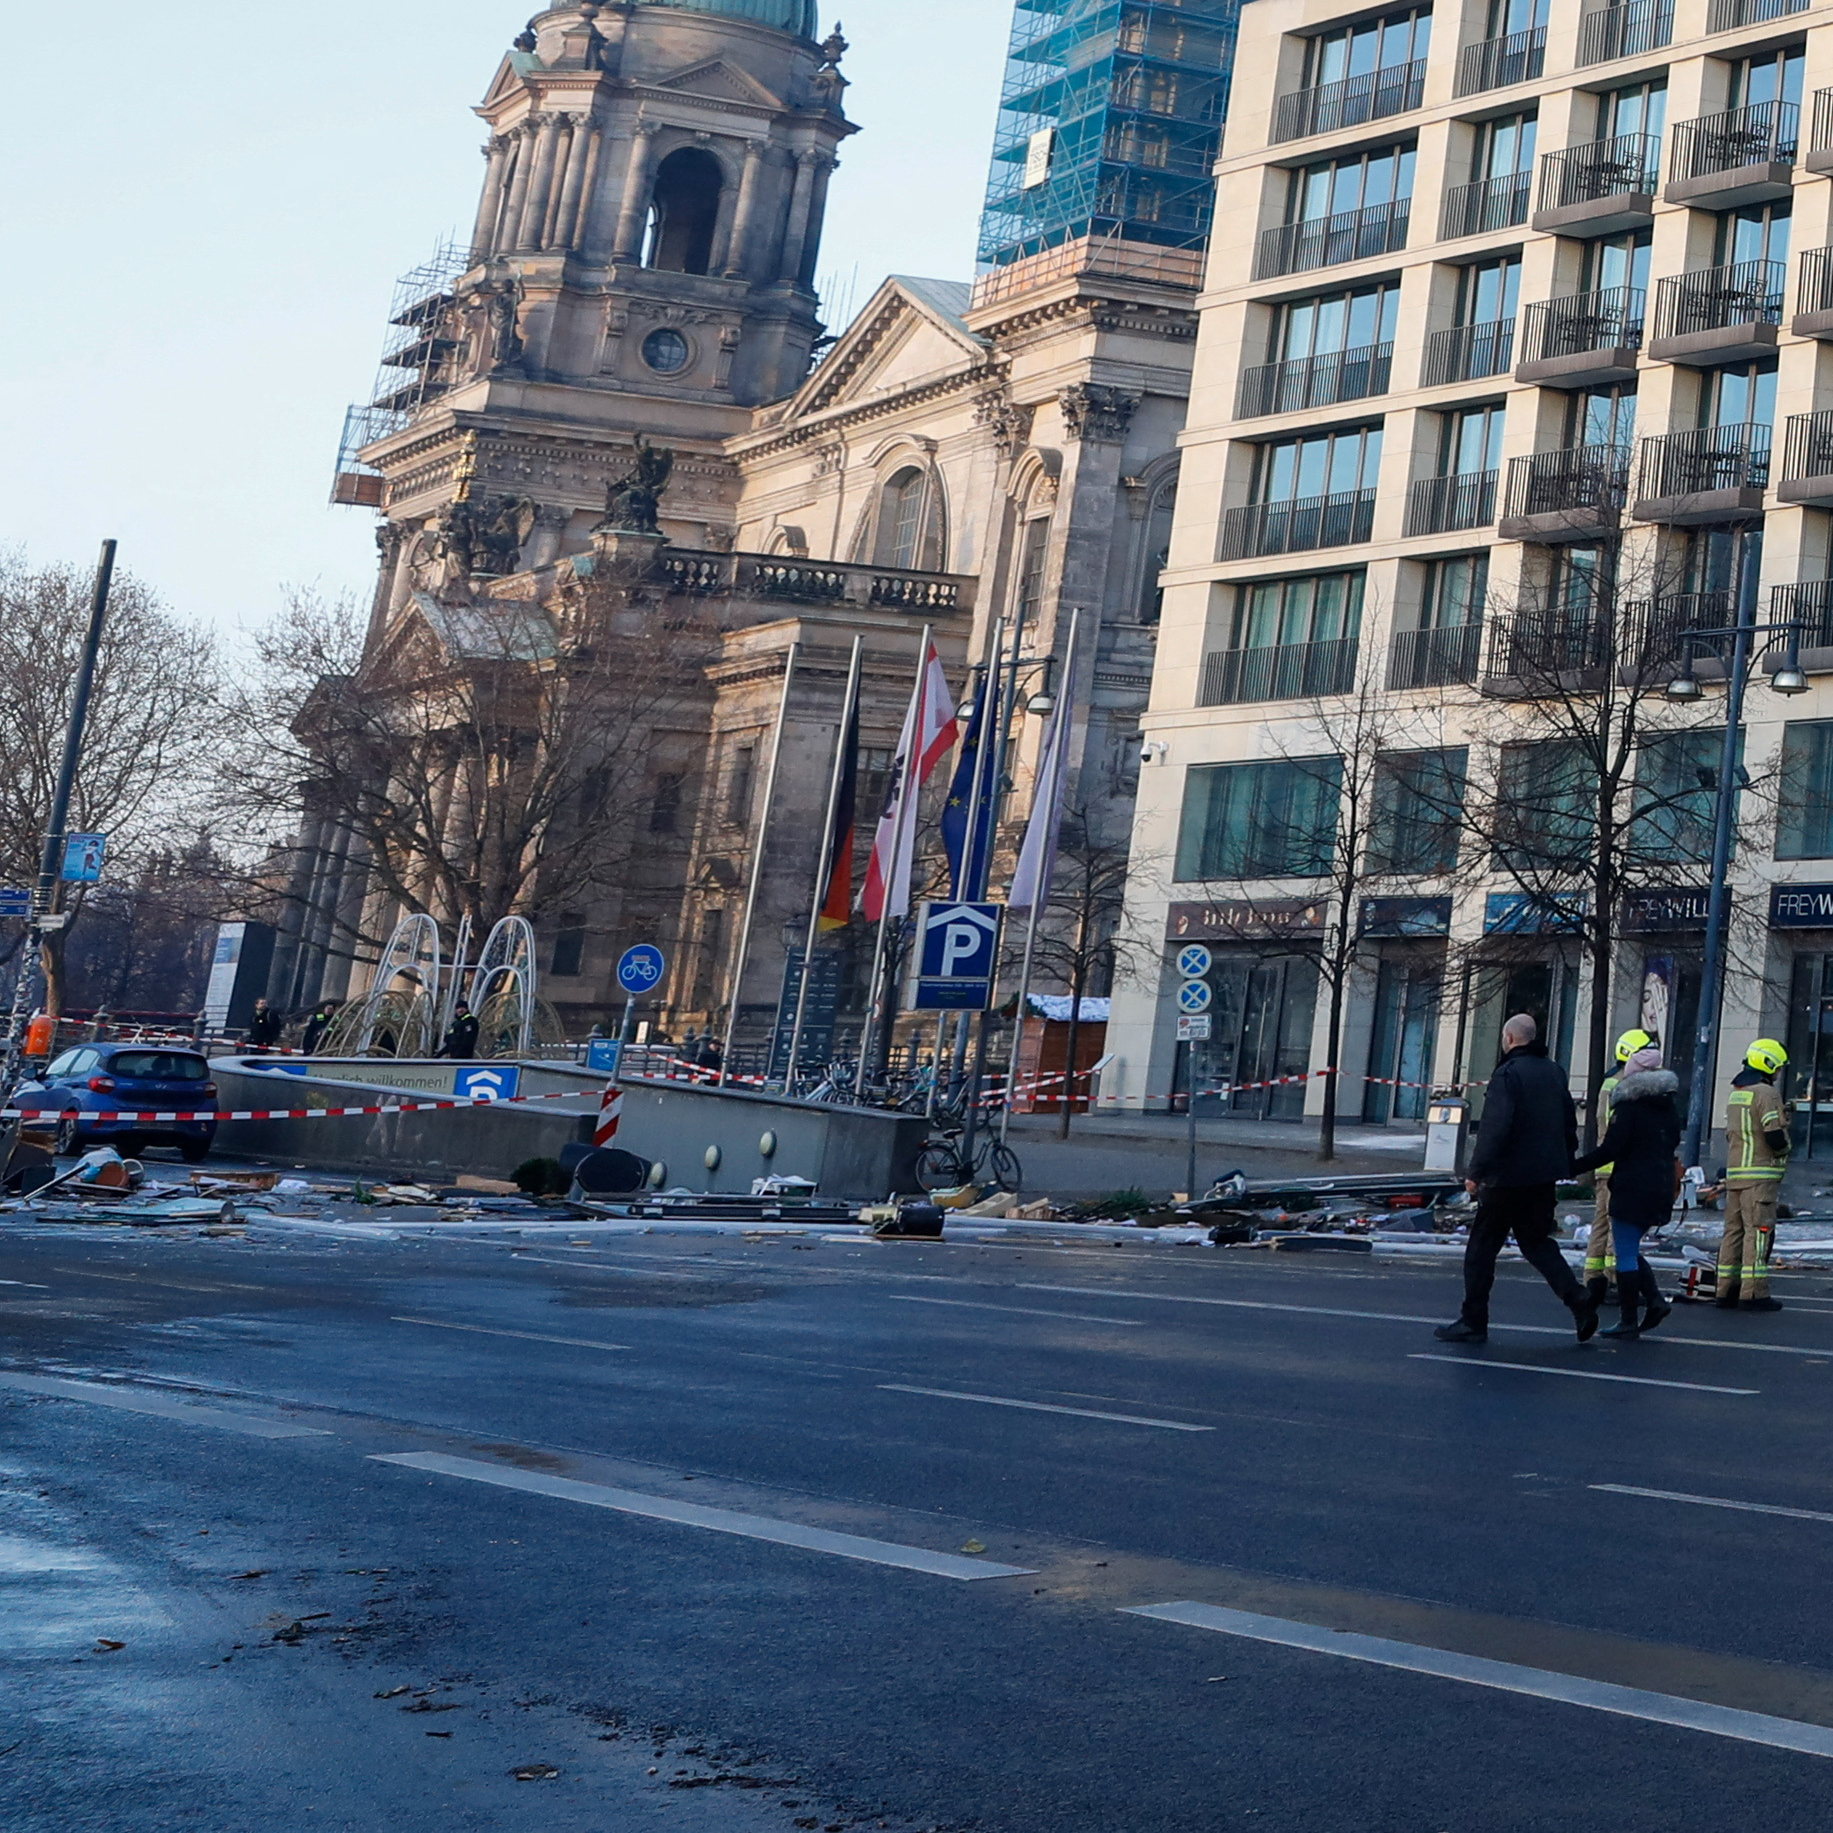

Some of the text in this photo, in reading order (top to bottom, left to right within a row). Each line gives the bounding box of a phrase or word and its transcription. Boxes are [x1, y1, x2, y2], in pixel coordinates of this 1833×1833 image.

[1628, 897, 1712, 919] FREYWILL
[941, 923, 981, 977] P
[367, 1075, 448, 1089] willkommen!
